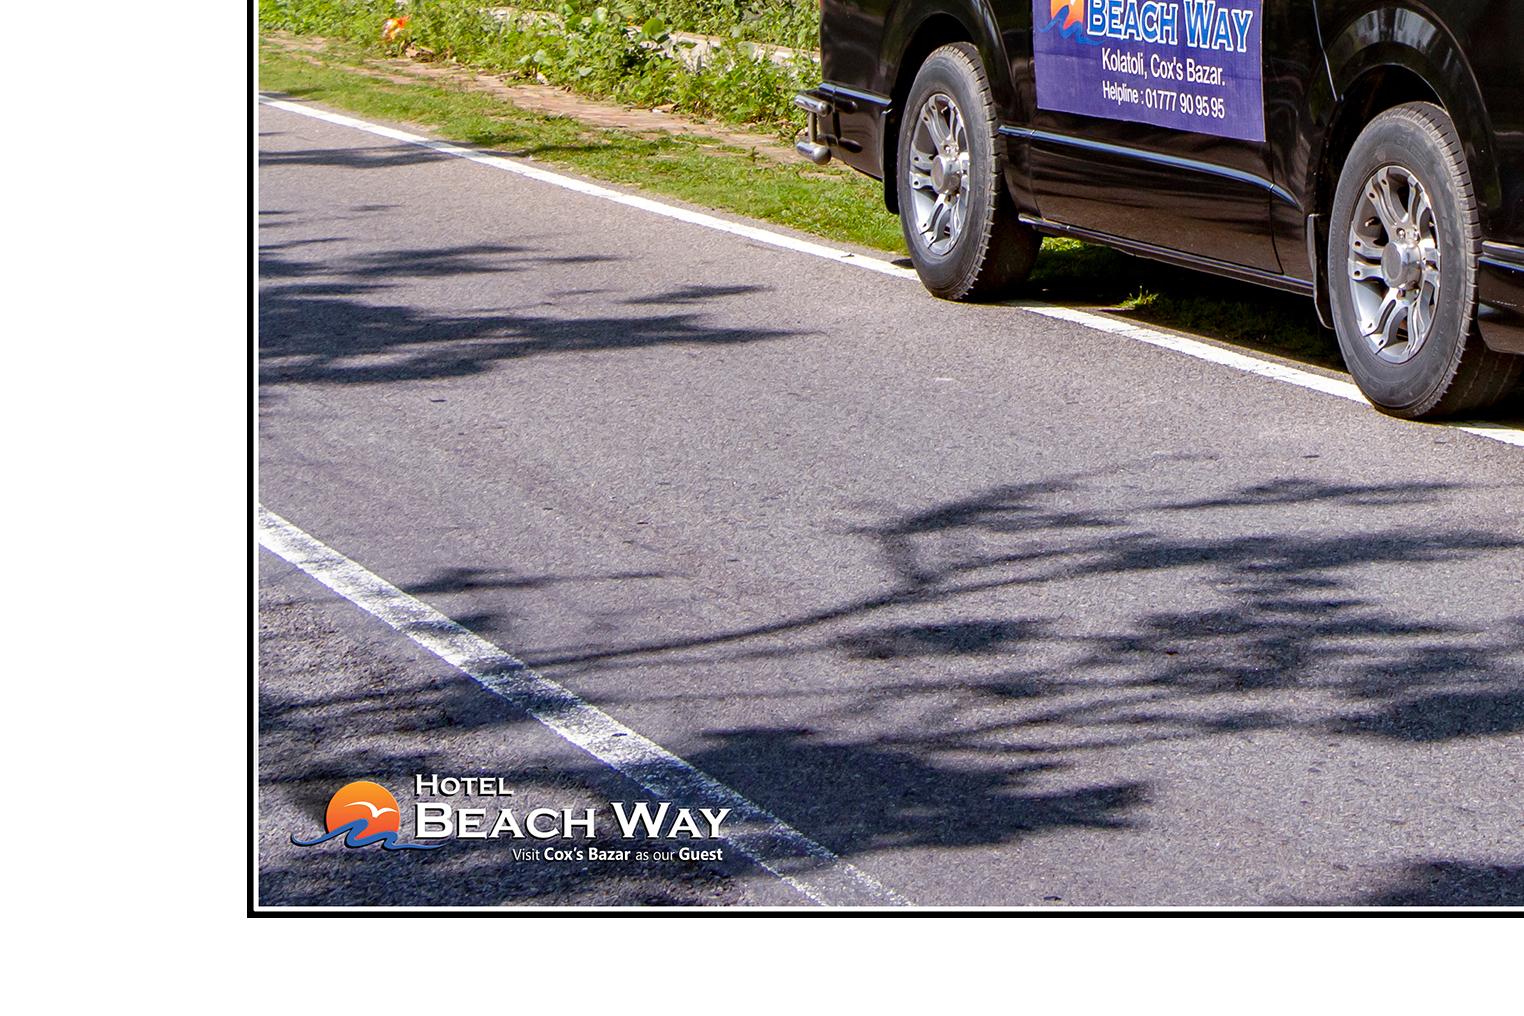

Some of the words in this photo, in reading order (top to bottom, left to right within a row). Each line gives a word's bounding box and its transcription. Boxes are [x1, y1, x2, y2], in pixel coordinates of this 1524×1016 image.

[1102, 47, 1148, 80] Kolatoli,
[1150, 53, 1184, 81] Cox's
[1186, 58, 1226, 86] Bazar.
[1102, 80, 1139, 105] Helpline
[1145, 88, 1178, 112] 01777
[1180, 93, 1194, 115] 90
[1196, 95, 1210, 117] 95
[1211, 97, 1225, 119] 95
